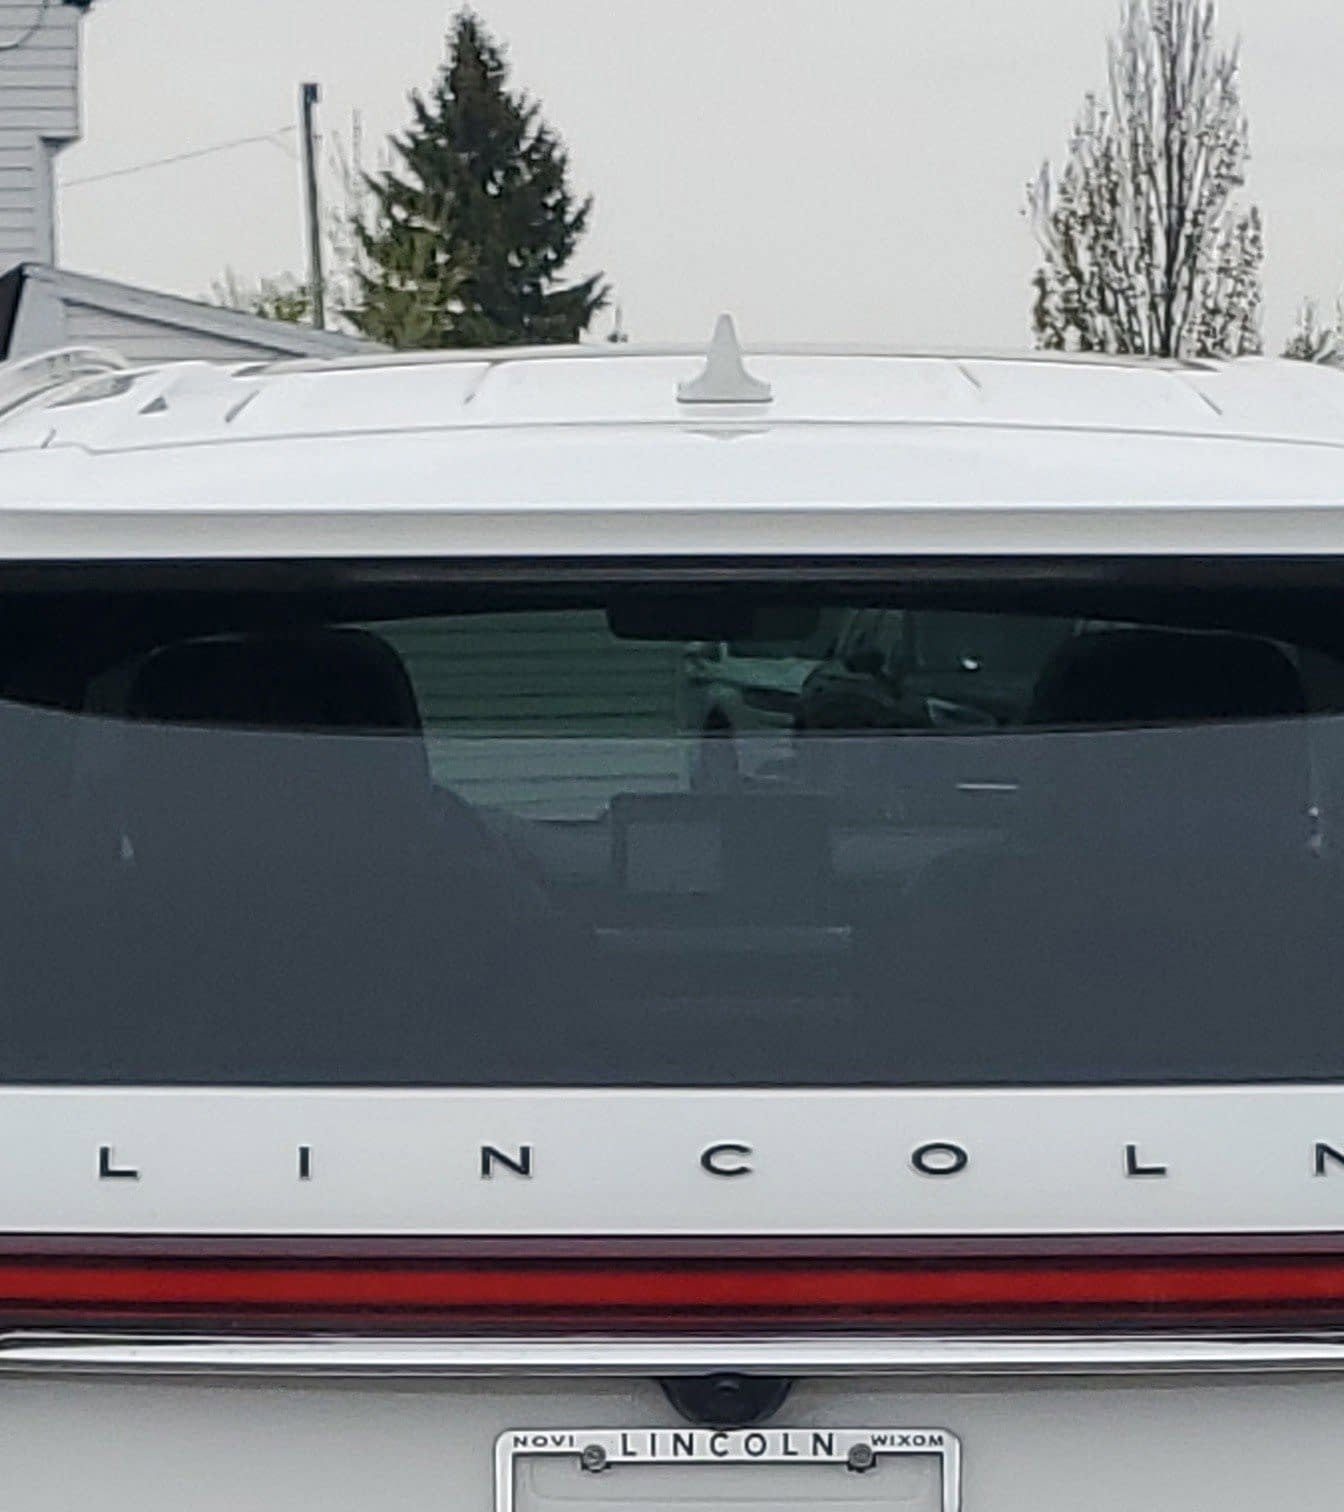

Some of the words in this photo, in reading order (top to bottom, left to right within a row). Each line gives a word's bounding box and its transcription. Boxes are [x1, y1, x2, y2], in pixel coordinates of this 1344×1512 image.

[513, 1435, 575, 1447] NOVI
[621, 1432, 835, 1456] LINCOLN
[871, 1434, 944, 1446] WIXOM
